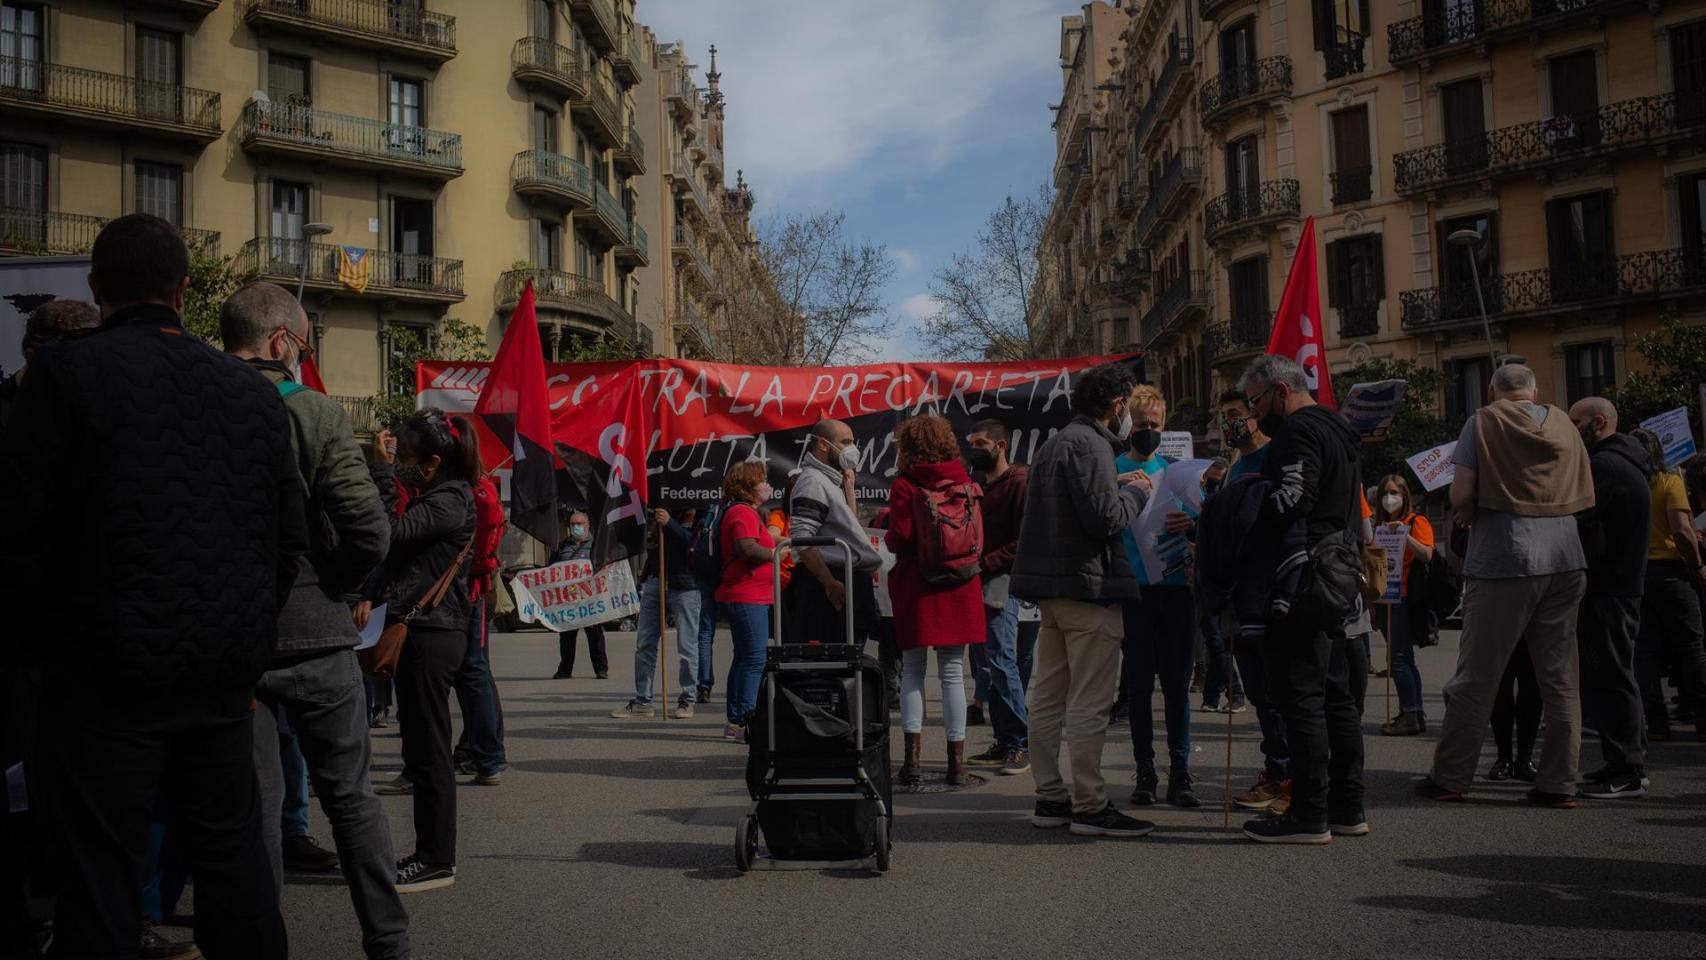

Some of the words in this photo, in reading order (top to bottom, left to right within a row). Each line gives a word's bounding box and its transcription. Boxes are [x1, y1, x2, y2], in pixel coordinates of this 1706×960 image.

[546, 367, 711, 416] COTRA
[729, 371, 786, 417] LA
[801, 366, 1091, 418] PRECARIETA
[1416, 448, 1441, 473] STOP
[660, 486, 722, 500] Federaci
[520, 563, 593, 589] TREBA
[540, 575, 609, 608] DIGNE
